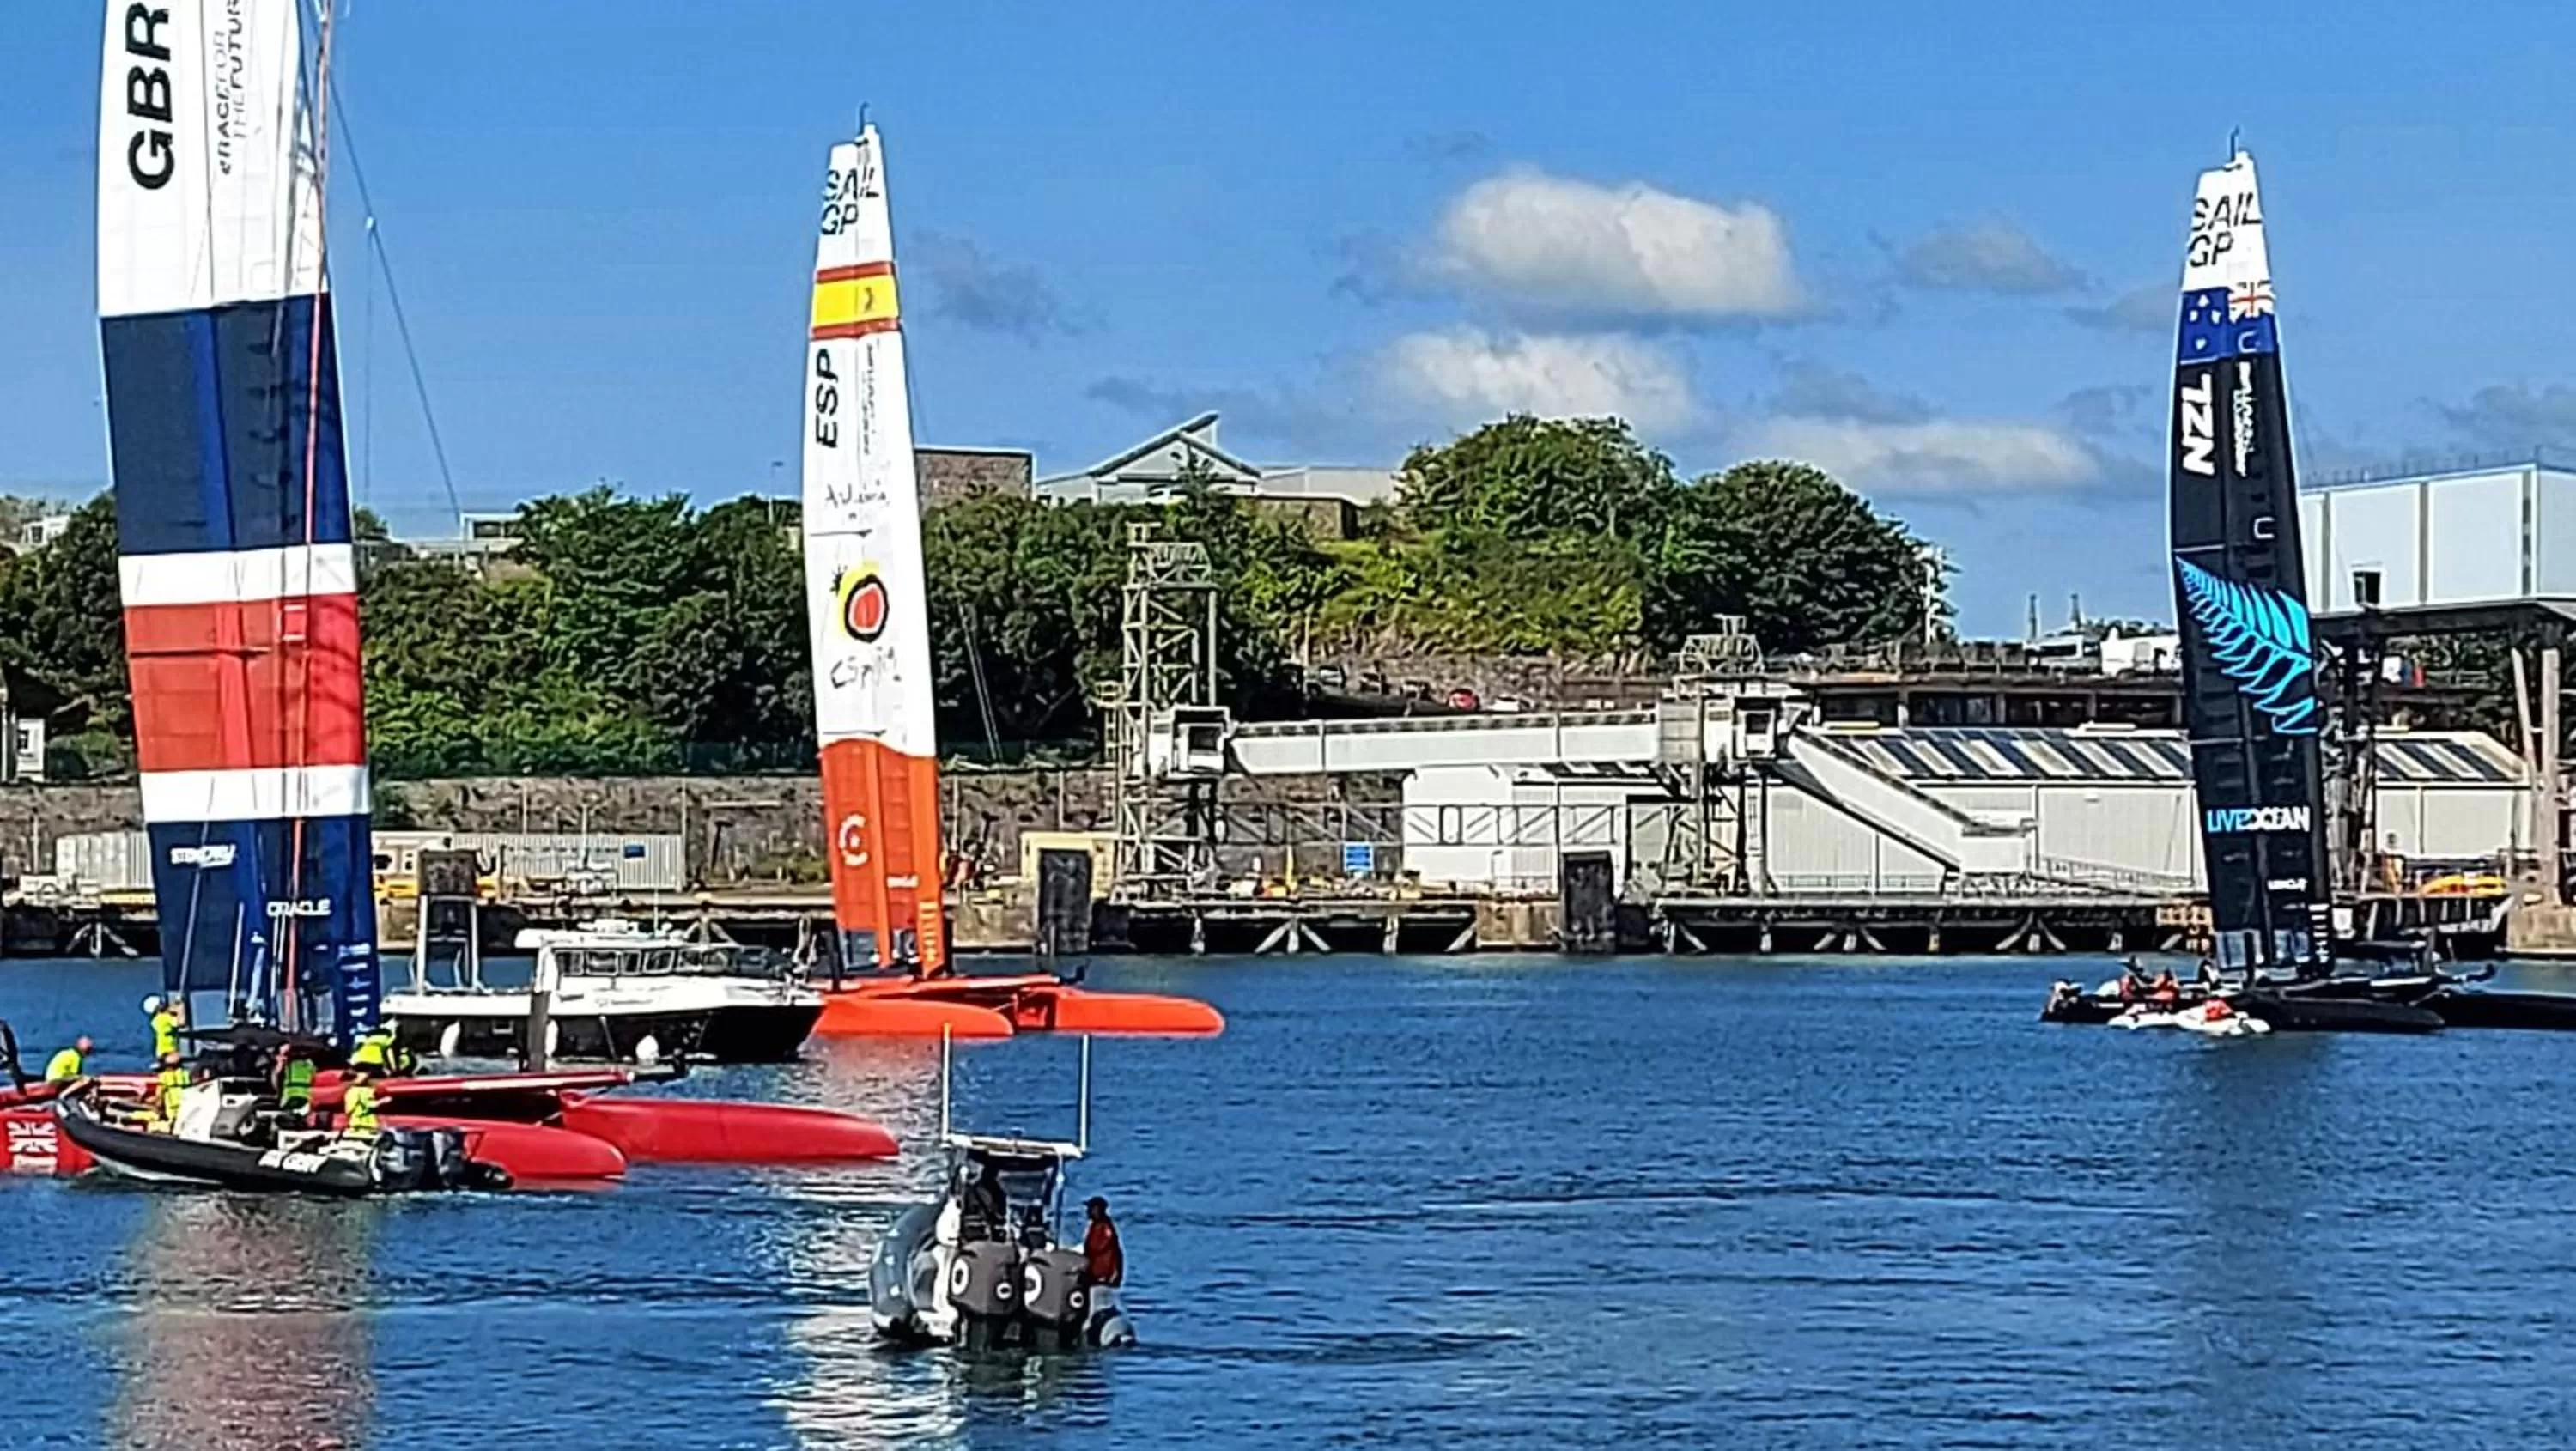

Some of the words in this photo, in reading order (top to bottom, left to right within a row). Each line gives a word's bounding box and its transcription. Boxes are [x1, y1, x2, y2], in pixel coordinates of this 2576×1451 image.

[125, 2, 174, 190] GBR
[822, 167, 879, 202] SAIL
[821, 203, 859, 235] GP
[2191, 191, 2263, 232] SAIL
[2187, 230, 2233, 267] GP
[815, 348, 839, 448] ESP
[2181, 374, 2215, 476] NZL
[265, 898, 332, 918] ORACLE
